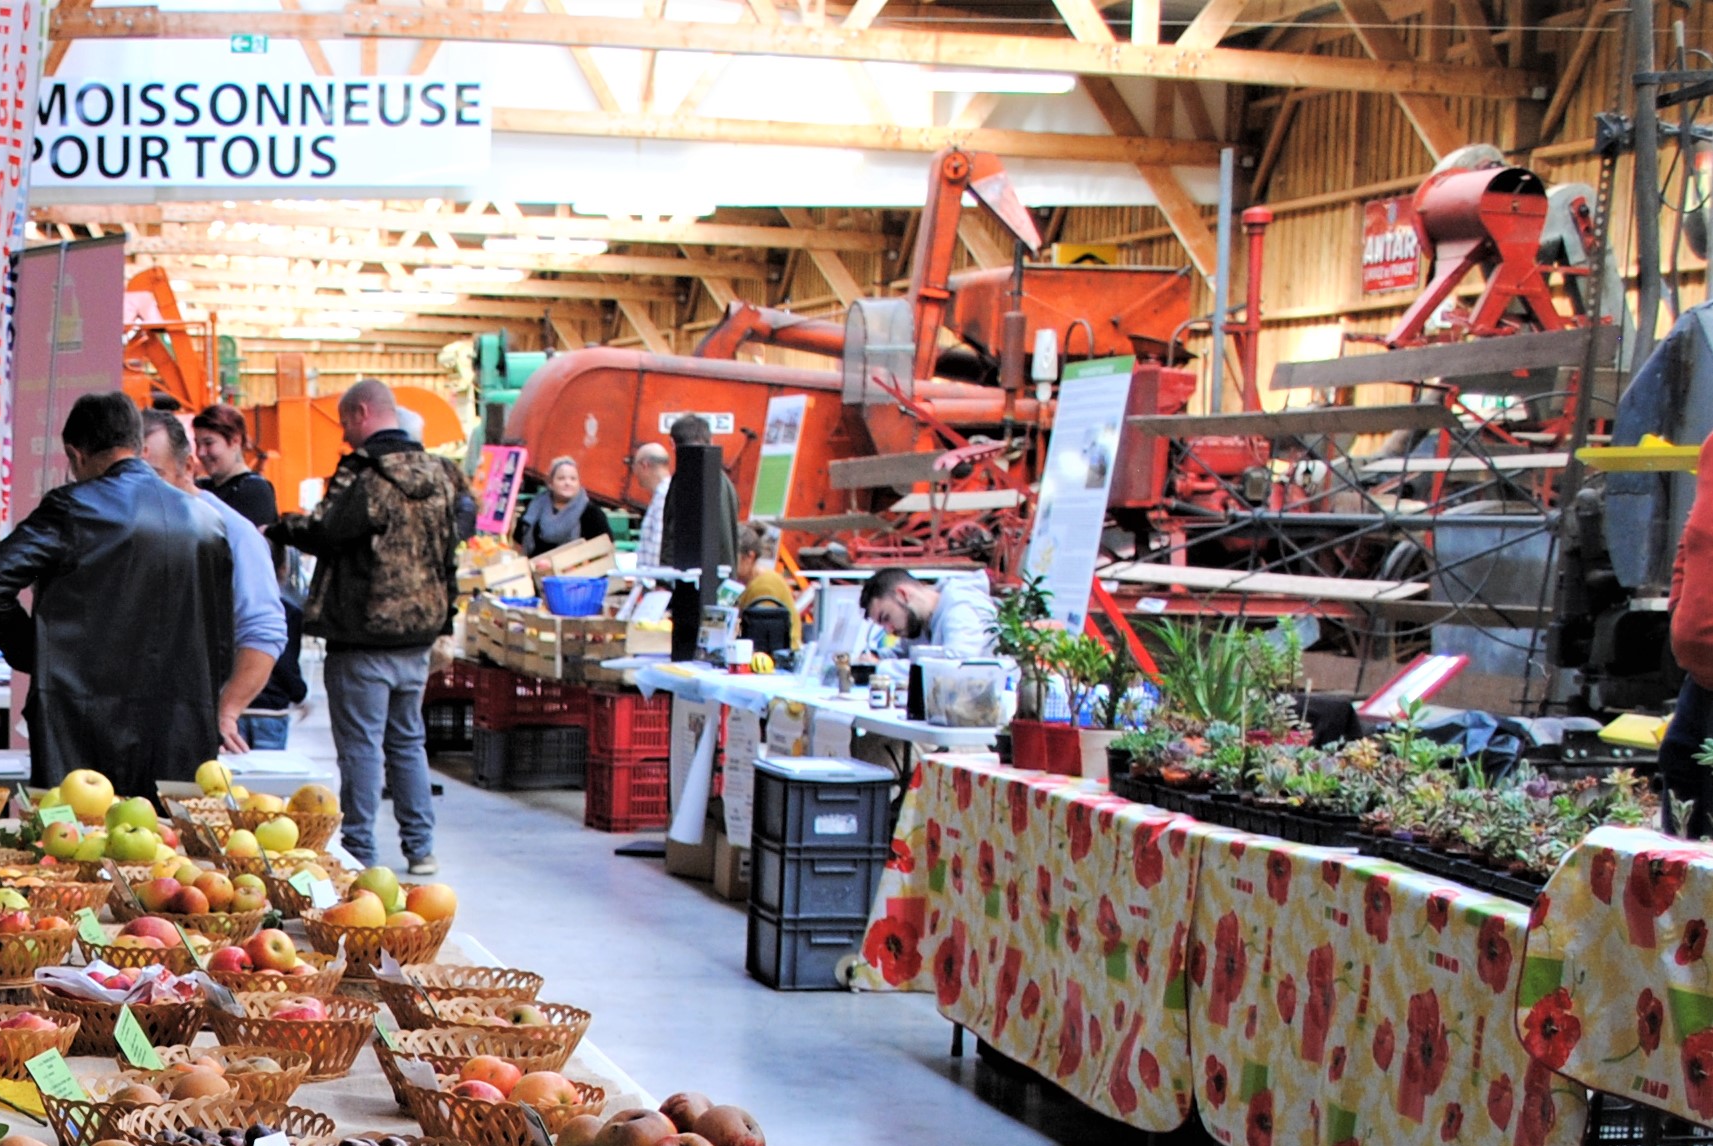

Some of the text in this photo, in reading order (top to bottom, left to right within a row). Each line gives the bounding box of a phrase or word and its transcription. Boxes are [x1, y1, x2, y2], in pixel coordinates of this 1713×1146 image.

[37, 82, 481, 127] MOISSONNEUSE
[187, 135, 338, 180] TOUS
[1363, 225, 1418, 265] ANTAR
[664, 414, 730, 429] CE
